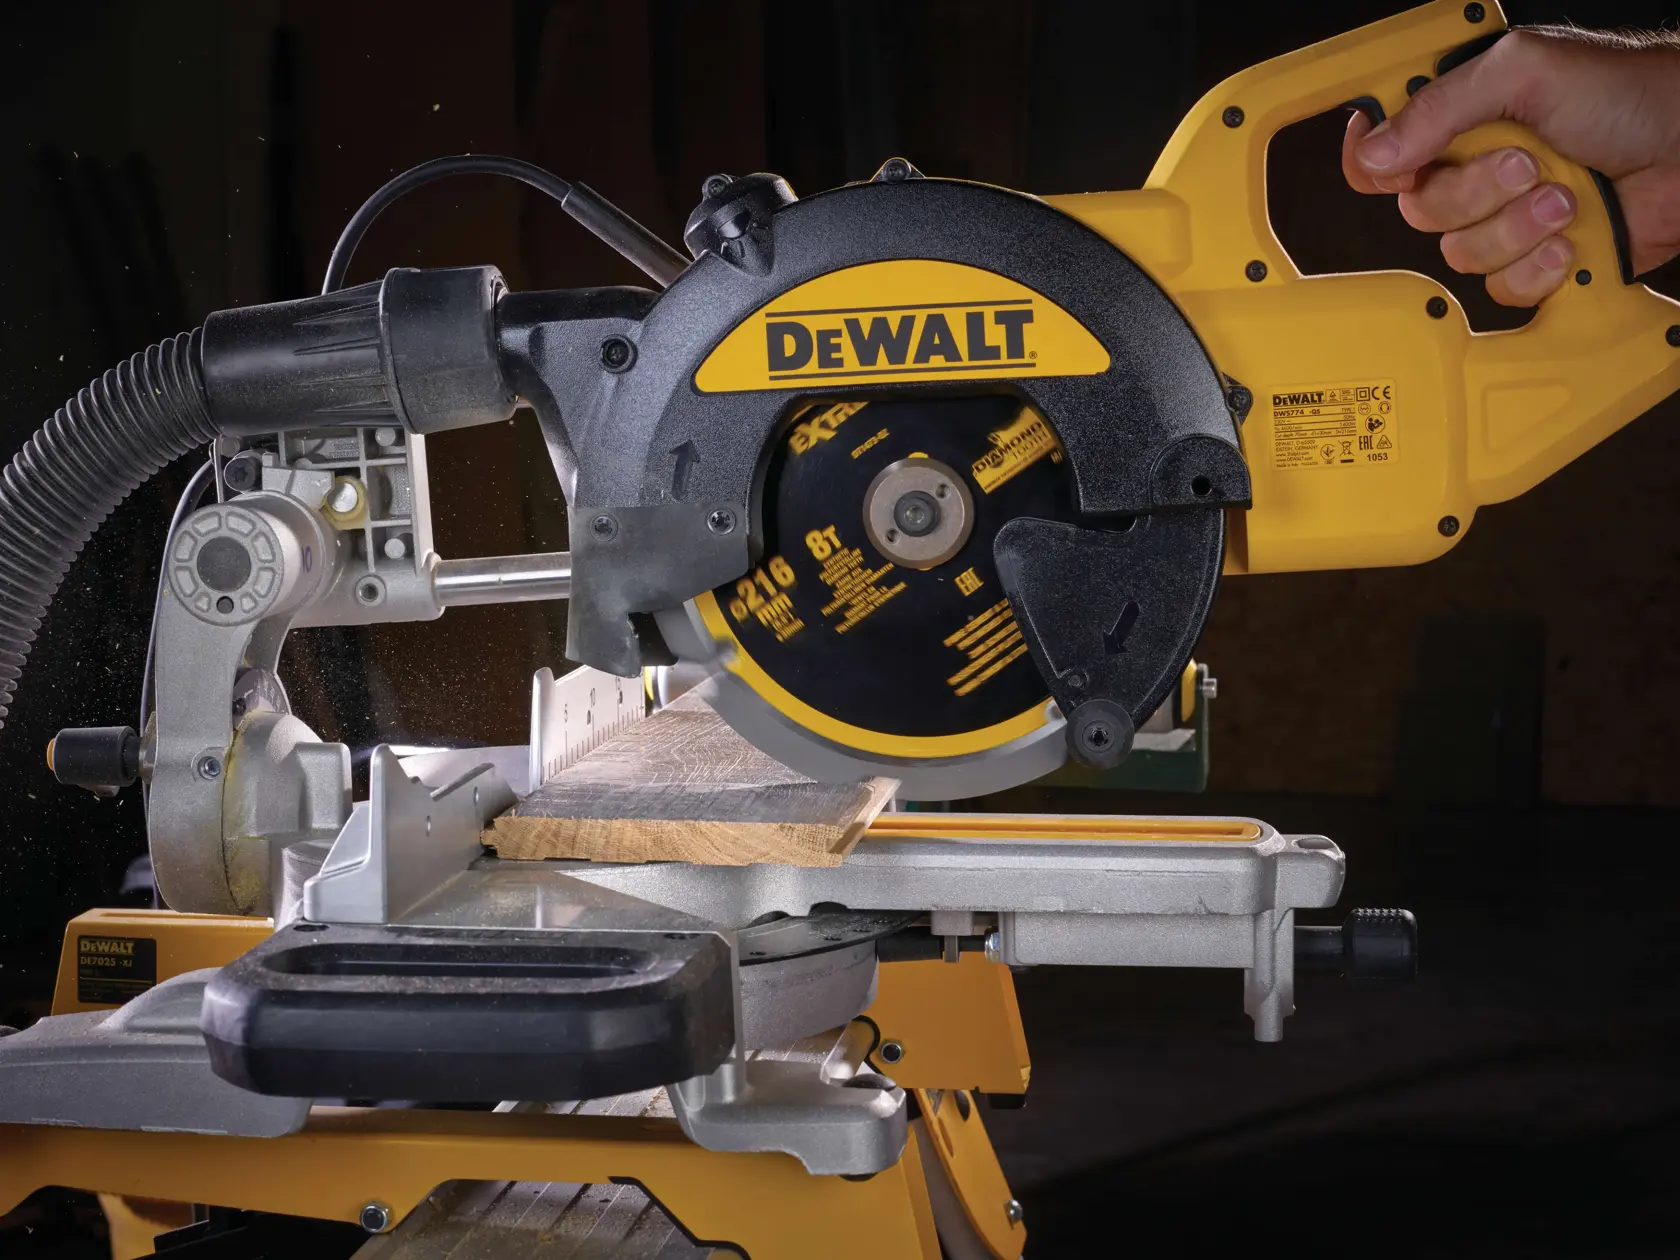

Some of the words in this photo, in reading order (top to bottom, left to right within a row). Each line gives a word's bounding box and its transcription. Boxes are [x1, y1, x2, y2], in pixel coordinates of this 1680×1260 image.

[1273, 409, 1304, 417] DWS774
[973, 421, 1043, 474] DIAMOND
[1367, 452, 1388, 462] 1053
[80, 956, 116, 967] DE7025
